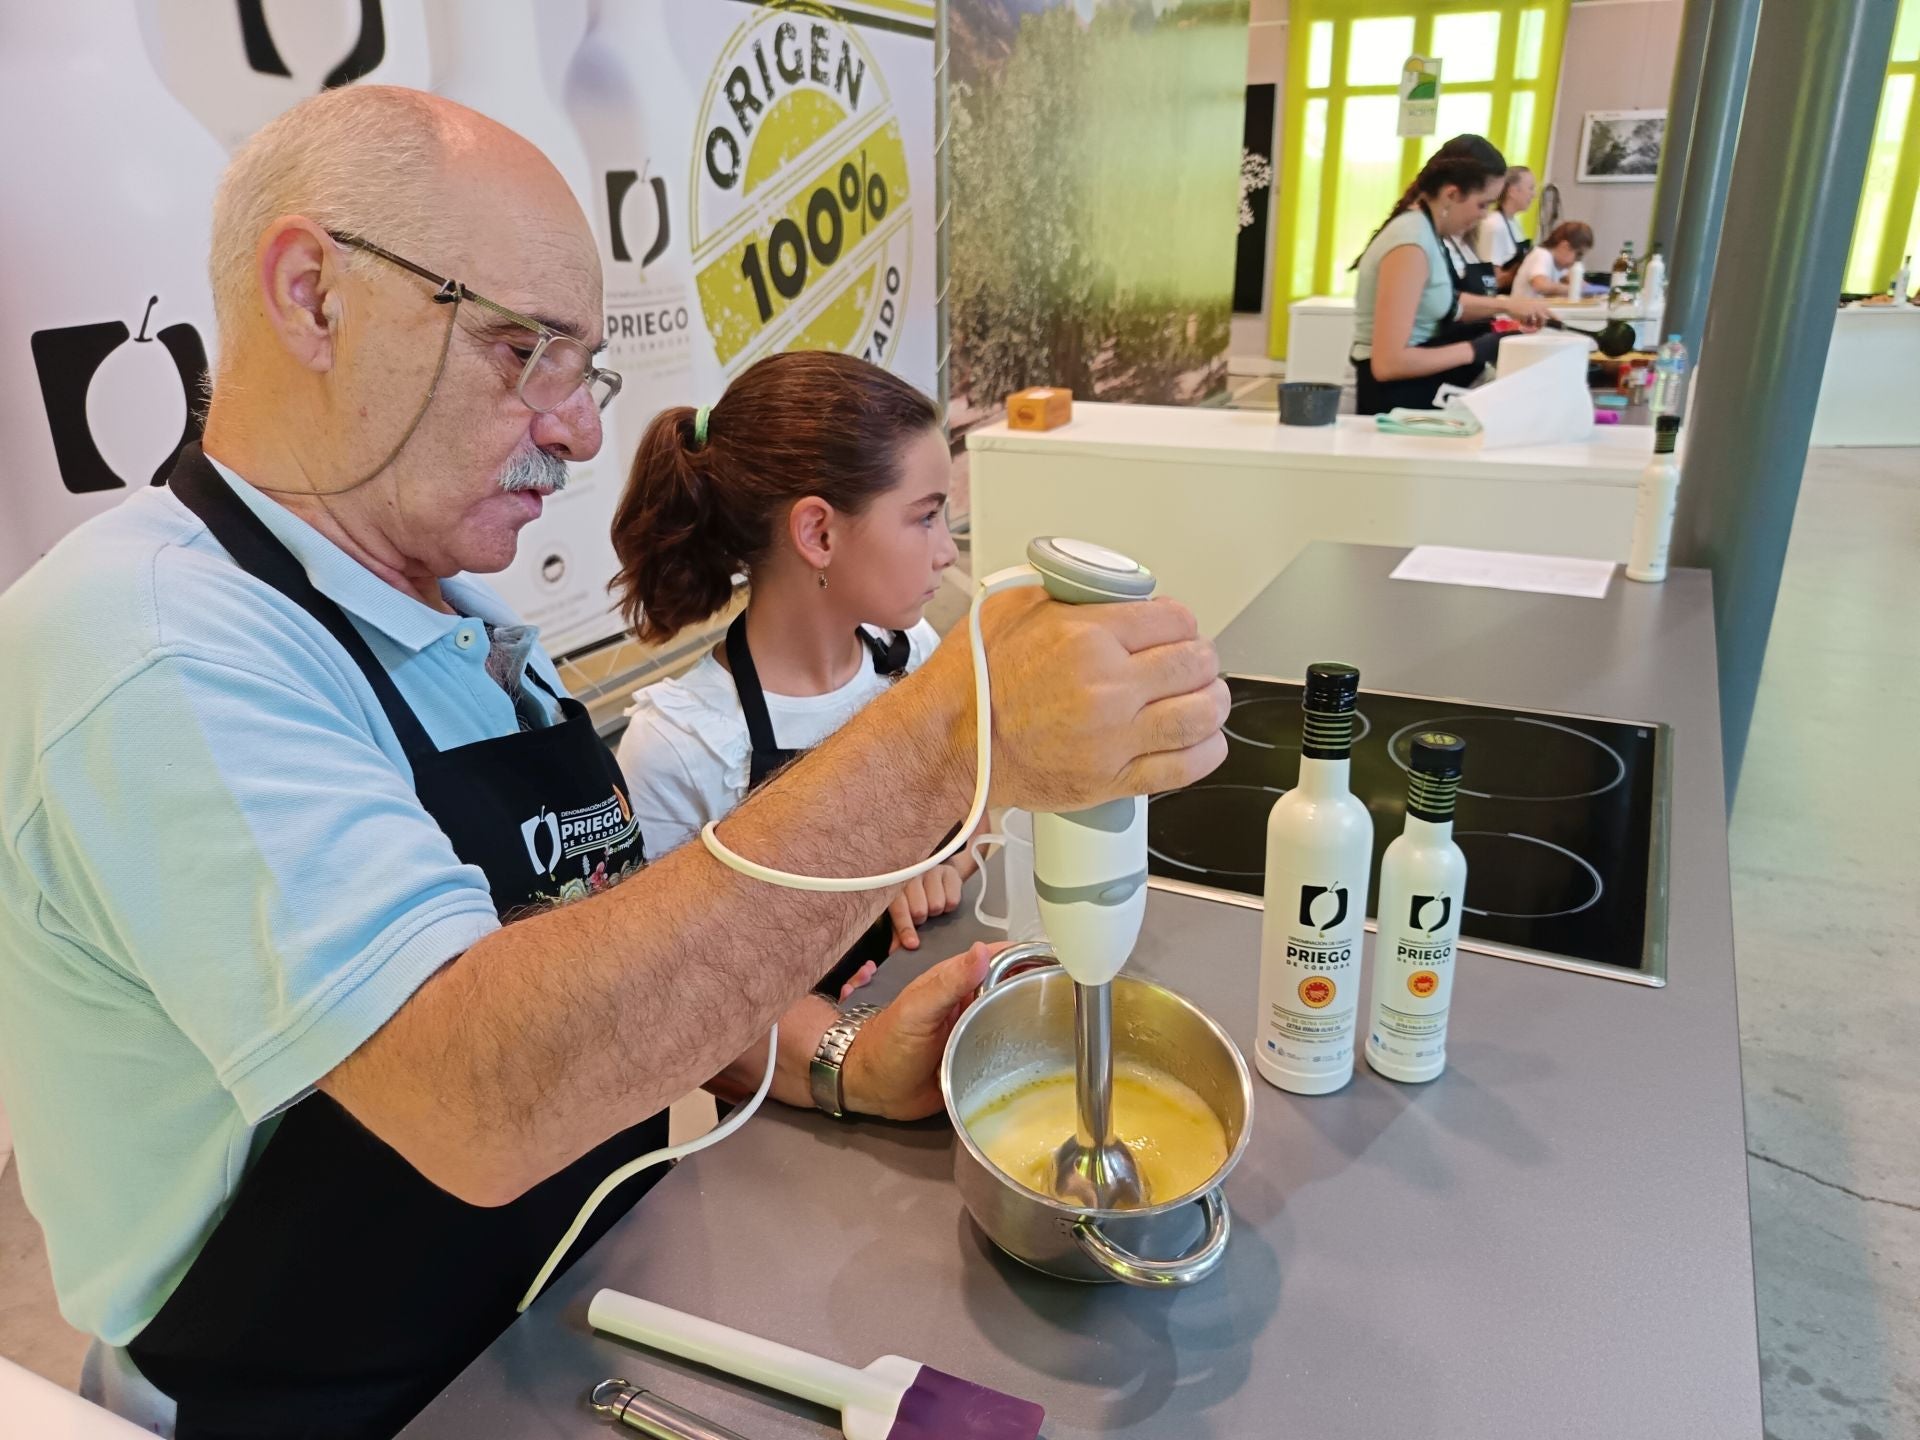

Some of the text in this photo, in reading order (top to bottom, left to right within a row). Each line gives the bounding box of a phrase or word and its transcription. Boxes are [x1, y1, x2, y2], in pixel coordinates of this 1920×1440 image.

[705, 22, 865, 190] ORIGEN
[741, 150, 888, 324] 100%
[607, 306, 689, 338] PRIEGO
[561, 807, 622, 840] PRIEGO
[563, 840, 575, 849] DE
[1286, 946, 1351, 964] PRIEGO
[1397, 945, 1451, 960] PRIEGO
